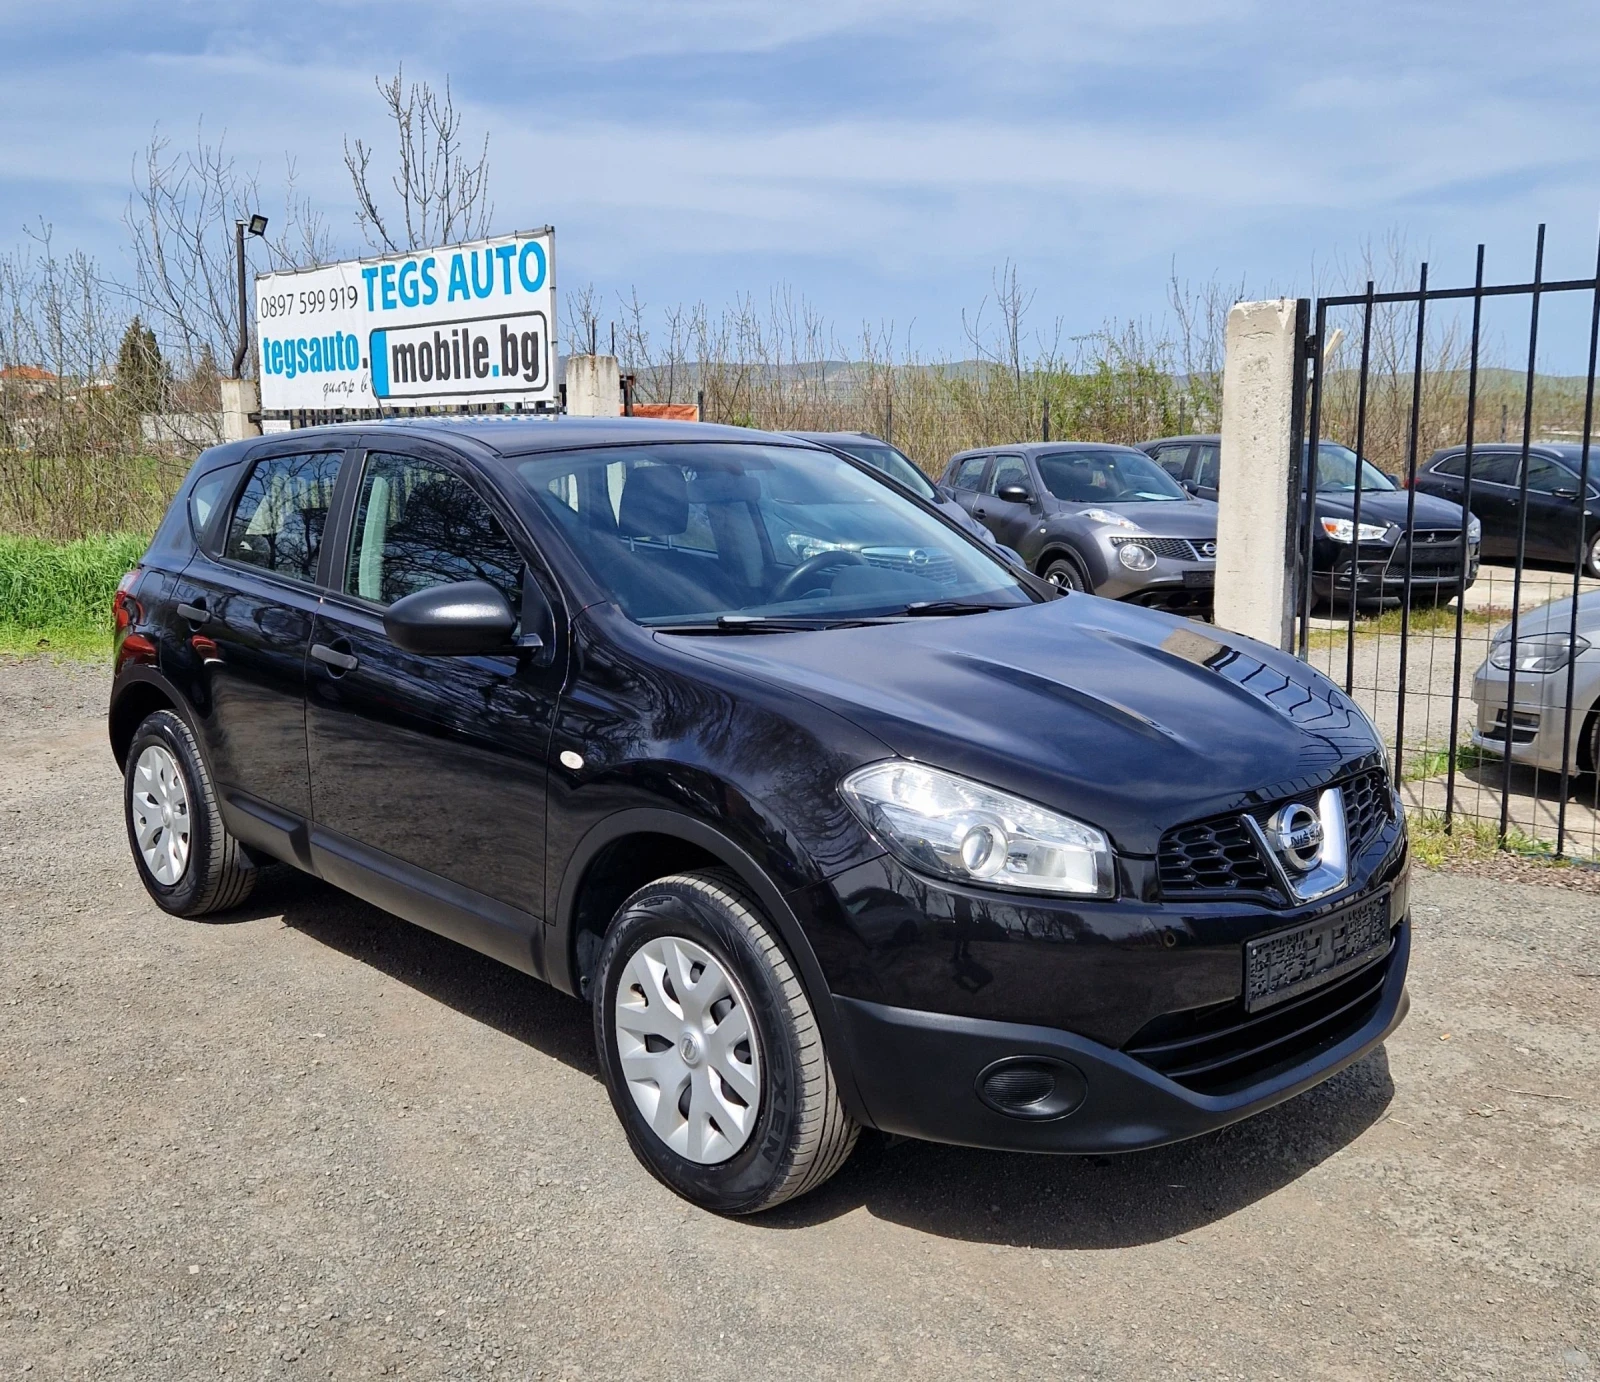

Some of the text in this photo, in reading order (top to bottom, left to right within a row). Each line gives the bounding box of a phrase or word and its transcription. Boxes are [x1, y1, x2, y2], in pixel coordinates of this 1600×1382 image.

[260, 285, 358, 319] 0897 599 919
[361, 241, 547, 312] TEGS AUTO
[391, 324, 539, 383] mobile.bg
